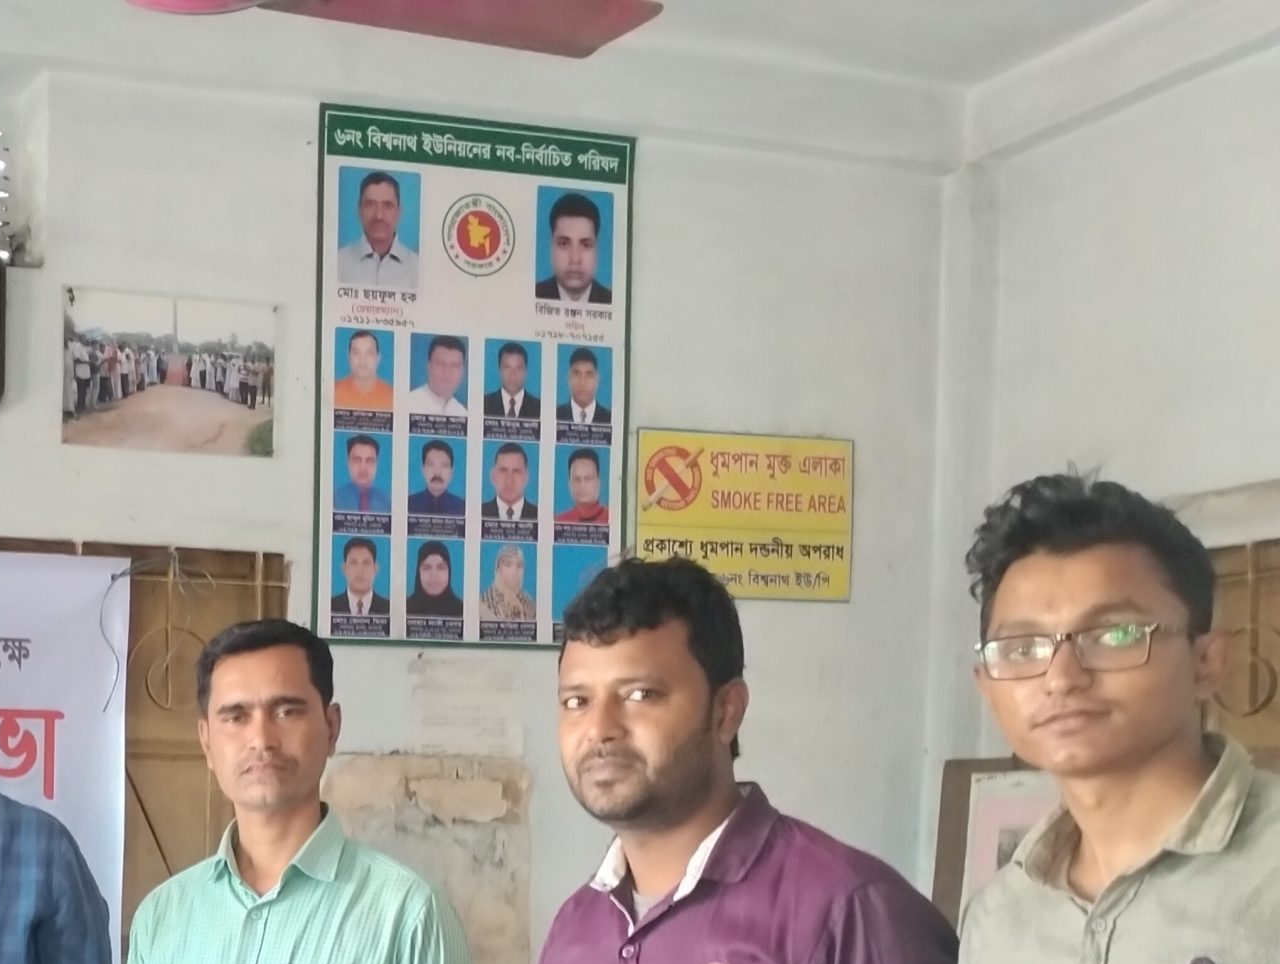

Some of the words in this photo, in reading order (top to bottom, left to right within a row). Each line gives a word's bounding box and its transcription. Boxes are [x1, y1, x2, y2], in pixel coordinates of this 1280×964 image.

[334, 128, 364, 149] ৬নং
[366, 125, 418, 152] বিশ্বনাথ
[421, 131, 491, 160] ইউনিয়নের
[495, 142, 572, 167] নব-নির্বাচিত
[577, 149, 620, 174] পরিষদ
[766, 453, 792, 480] মুক্ত
[799, 456, 846, 480] এলাকা
[711, 489, 761, 511] SMOKE
[767, 491, 803, 513] FREE
[807, 493, 847, 514] AREA
[798, 543, 844, 562] অপরাধ
